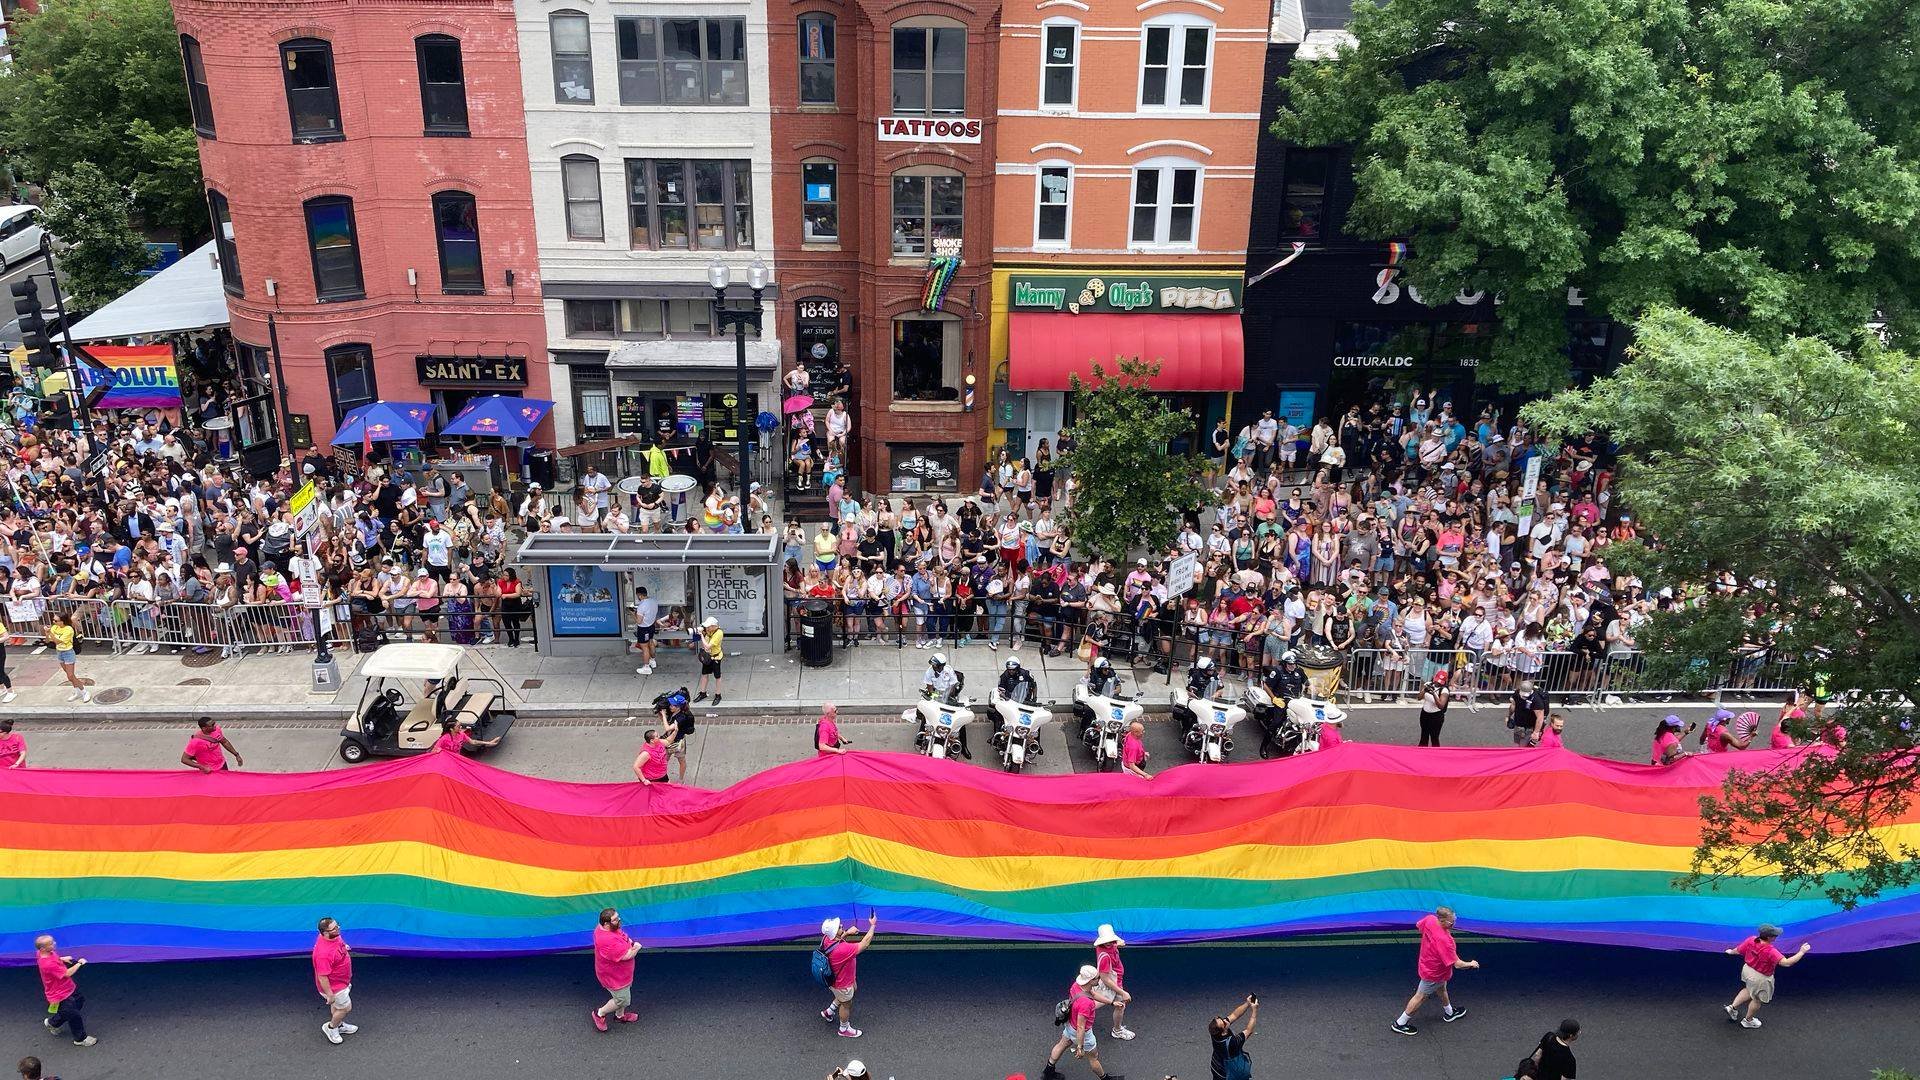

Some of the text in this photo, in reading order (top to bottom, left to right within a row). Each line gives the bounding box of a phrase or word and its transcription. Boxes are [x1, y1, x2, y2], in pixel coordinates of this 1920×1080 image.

[881, 120, 980, 138] TATTOOS
[933, 239, 962, 247] SMOKE
[936, 248, 960, 256] SHOP
[1016, 282, 1235, 310] Manny & Olga's PIZZA
[800, 302, 838, 318] 1843
[1334, 356, 1413, 367] CULTURALDC
[1459, 358, 1480, 367] 1835
[79, 367, 174, 387] ABSOLUT.
[706, 569, 731, 579] THE
[708, 580, 749, 589] PAPER
[707, 590, 757, 600] CEILING
[706, 600, 738, 610] .ORG
